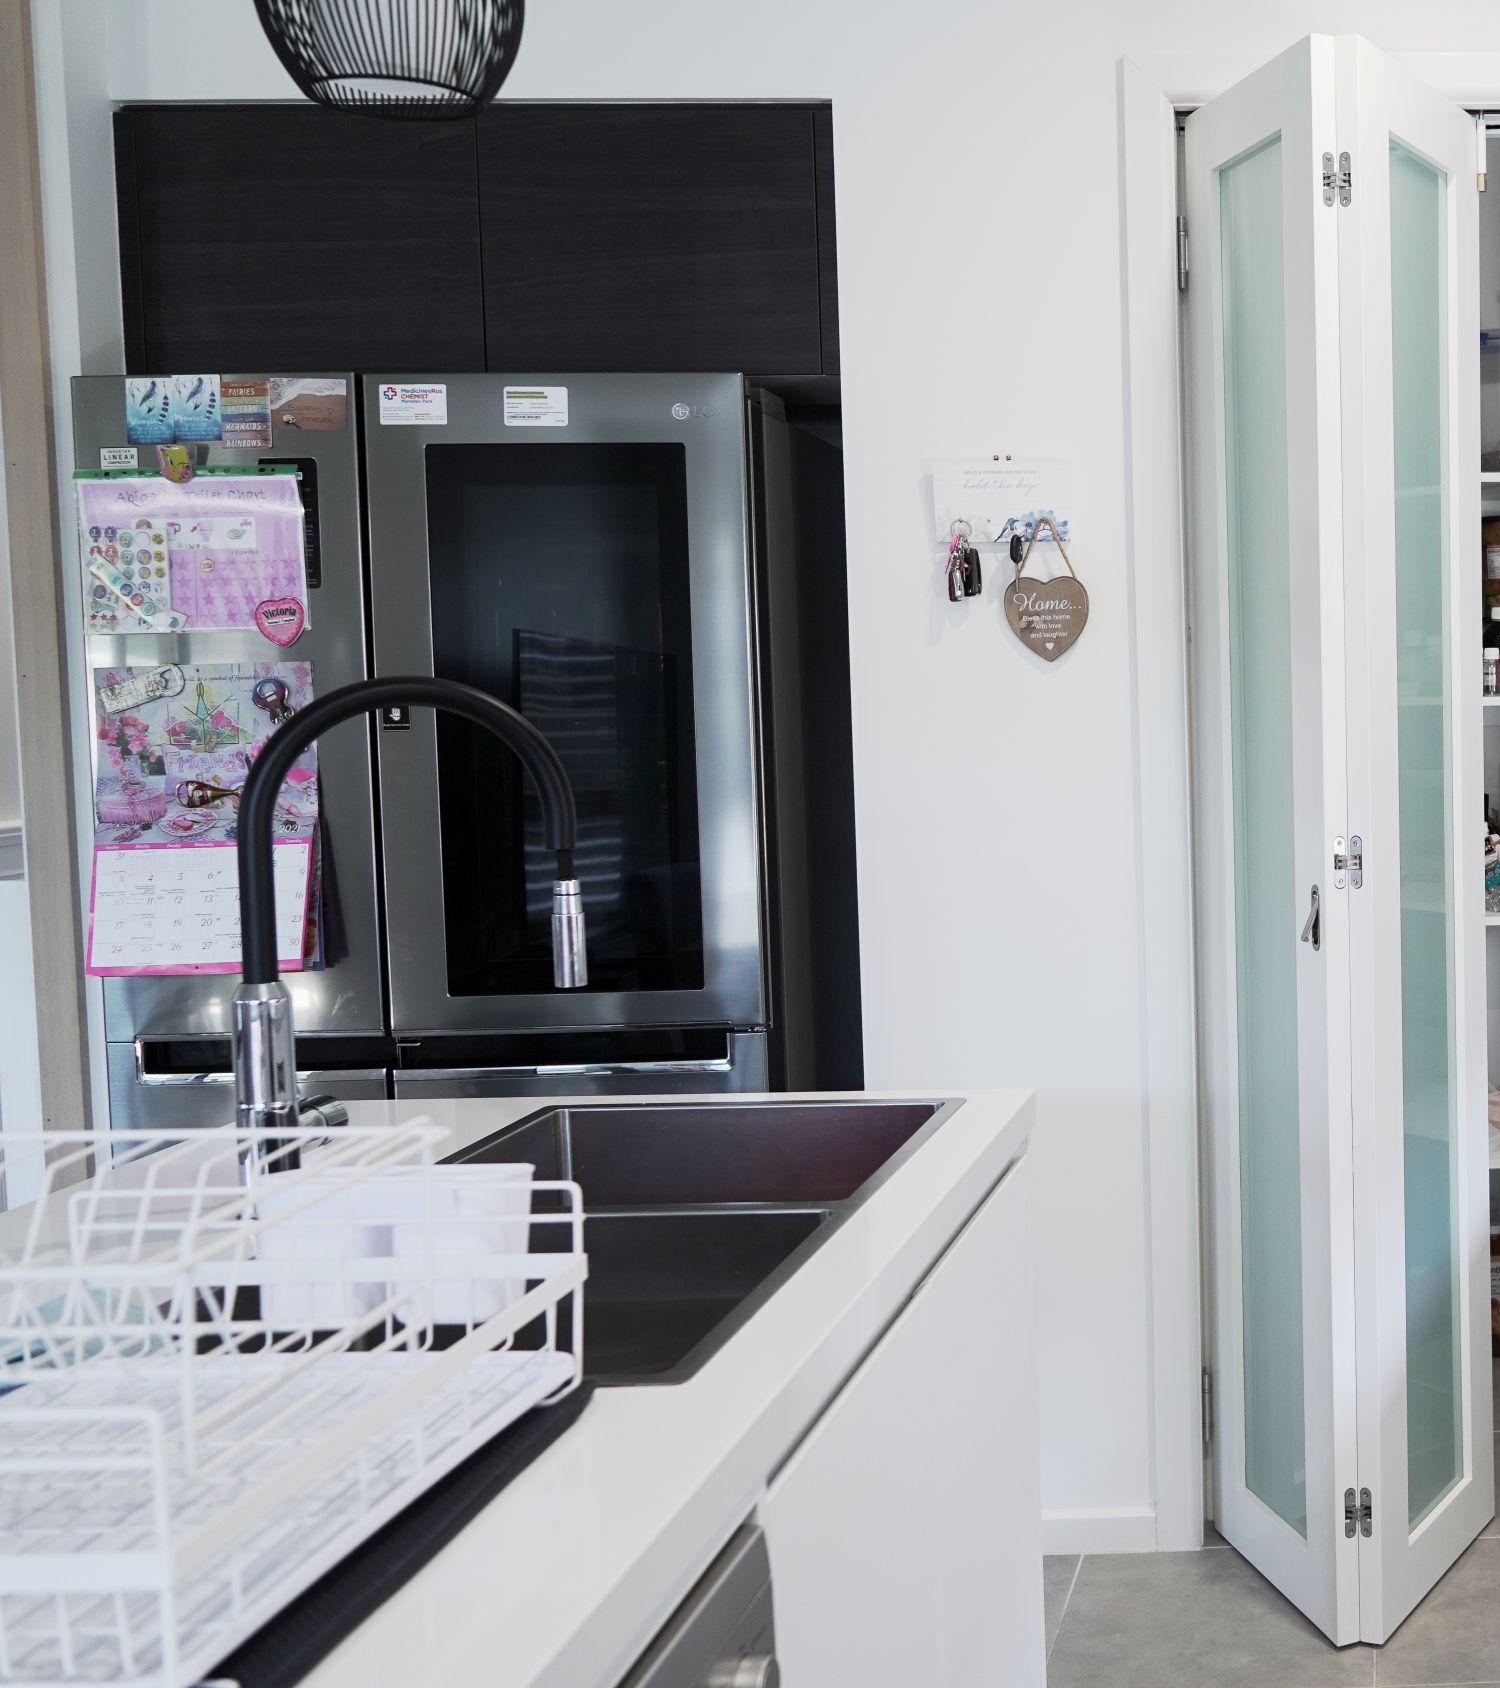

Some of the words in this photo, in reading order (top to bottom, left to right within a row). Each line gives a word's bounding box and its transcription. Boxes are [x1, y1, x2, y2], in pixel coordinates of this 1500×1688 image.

[228, 388, 255, 396] FAIRIES
[225, 423, 262, 431] MERMAIDS
[262, 606, 297, 620] Victoria
[1043, 631, 1068, 639] laughter
[280, 824, 300, 833] 2021
[174, 896, 183, 904] 12
[203, 894, 214, 903] 13
[172, 918, 183, 927] 19
[200, 918, 213, 927] 20
[169, 942, 182, 951] 26
[201, 941, 213, 950] 27
